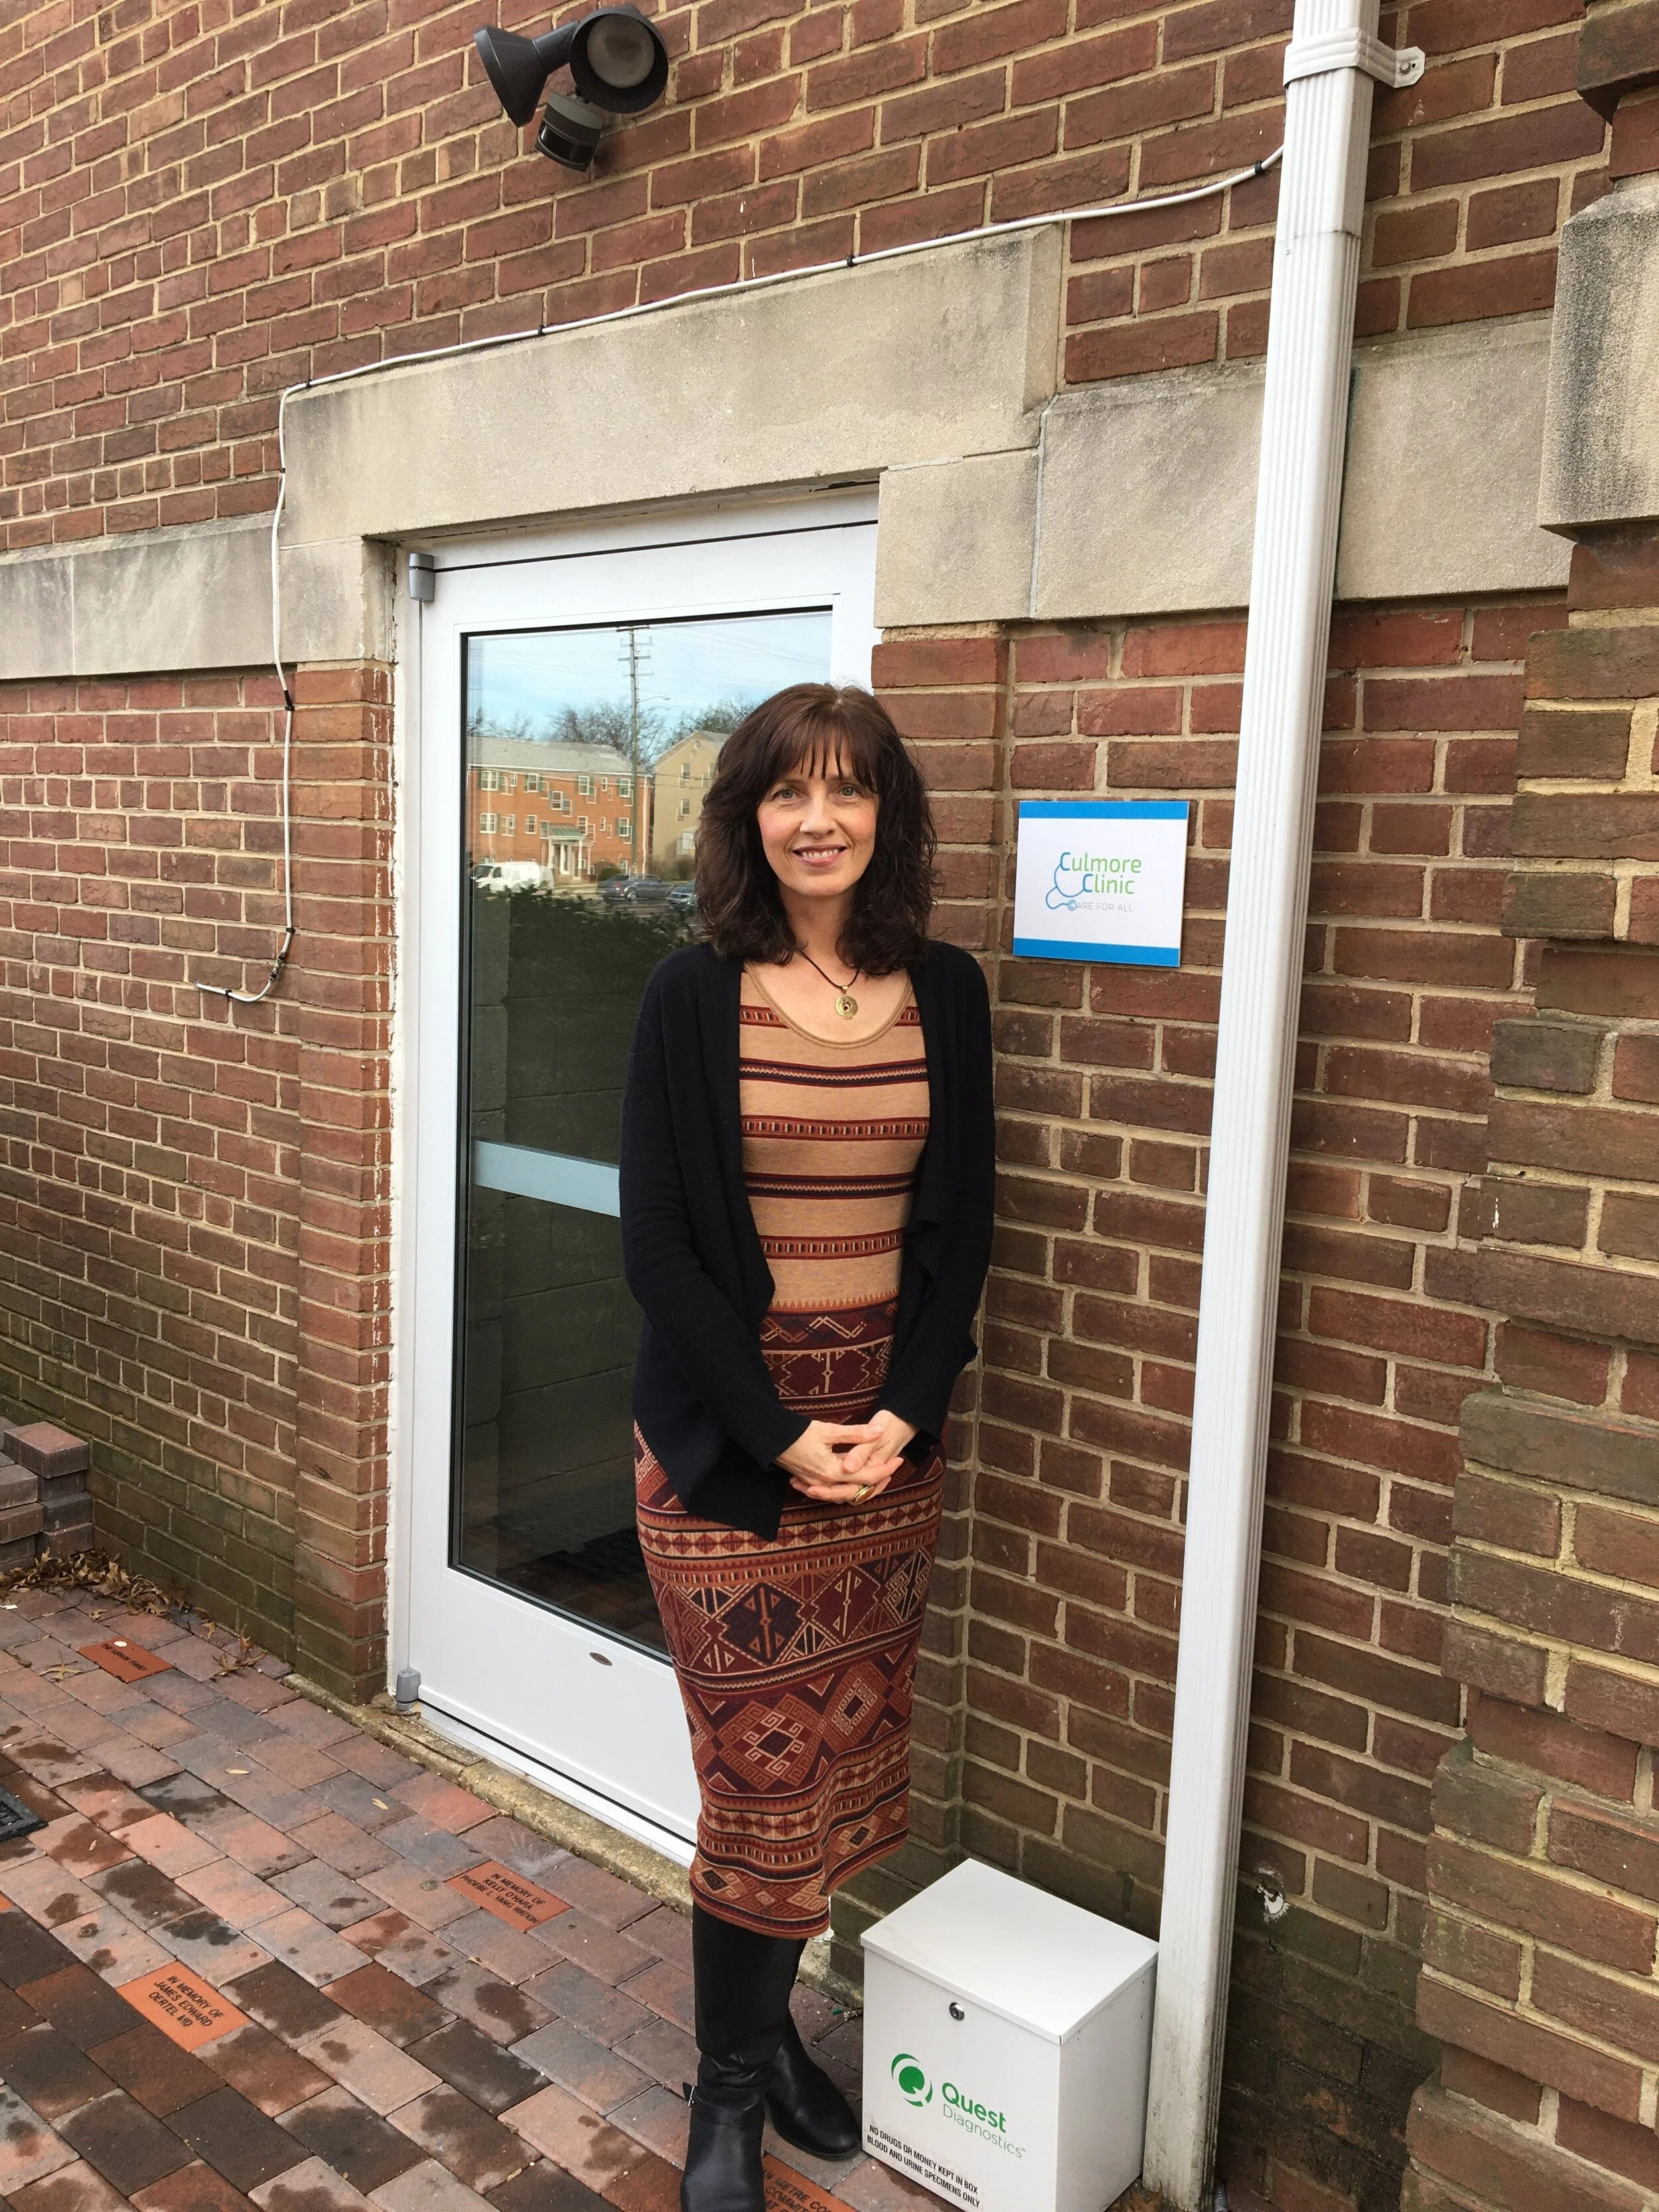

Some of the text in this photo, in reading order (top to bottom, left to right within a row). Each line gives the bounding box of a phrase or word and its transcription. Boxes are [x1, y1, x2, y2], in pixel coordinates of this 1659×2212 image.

[1060, 852, 1142, 873] Culmore
[1082, 873, 1135, 894] Clinic
[1068, 900, 1093, 911] CARE
[1096, 903, 1114, 911] FOR
[460, 1875, 488, 1893] PHOEBE
[494, 1895, 514, 1908] YANG
[513, 1906, 540, 1924] WATKIN
[483, 1879, 534, 1910] KELLY O'HARA
[500, 1878, 534, 1898] MEMORY
[532, 1897, 546, 1905] OF
[149, 1992, 193, 2027] OERTEL MD
[154, 1982, 213, 2027] JAMES EDWARD
[167, 1975, 224, 2019] IN MEMORY OF
[942, 2082, 1007, 2133] Quest
[867, 2135, 980, 2208] BLOOD AND URINE SPECIMENS ONLY
[869, 2124, 978, 2195] NO DRUGS OR MONEY KEPT IN BOX
